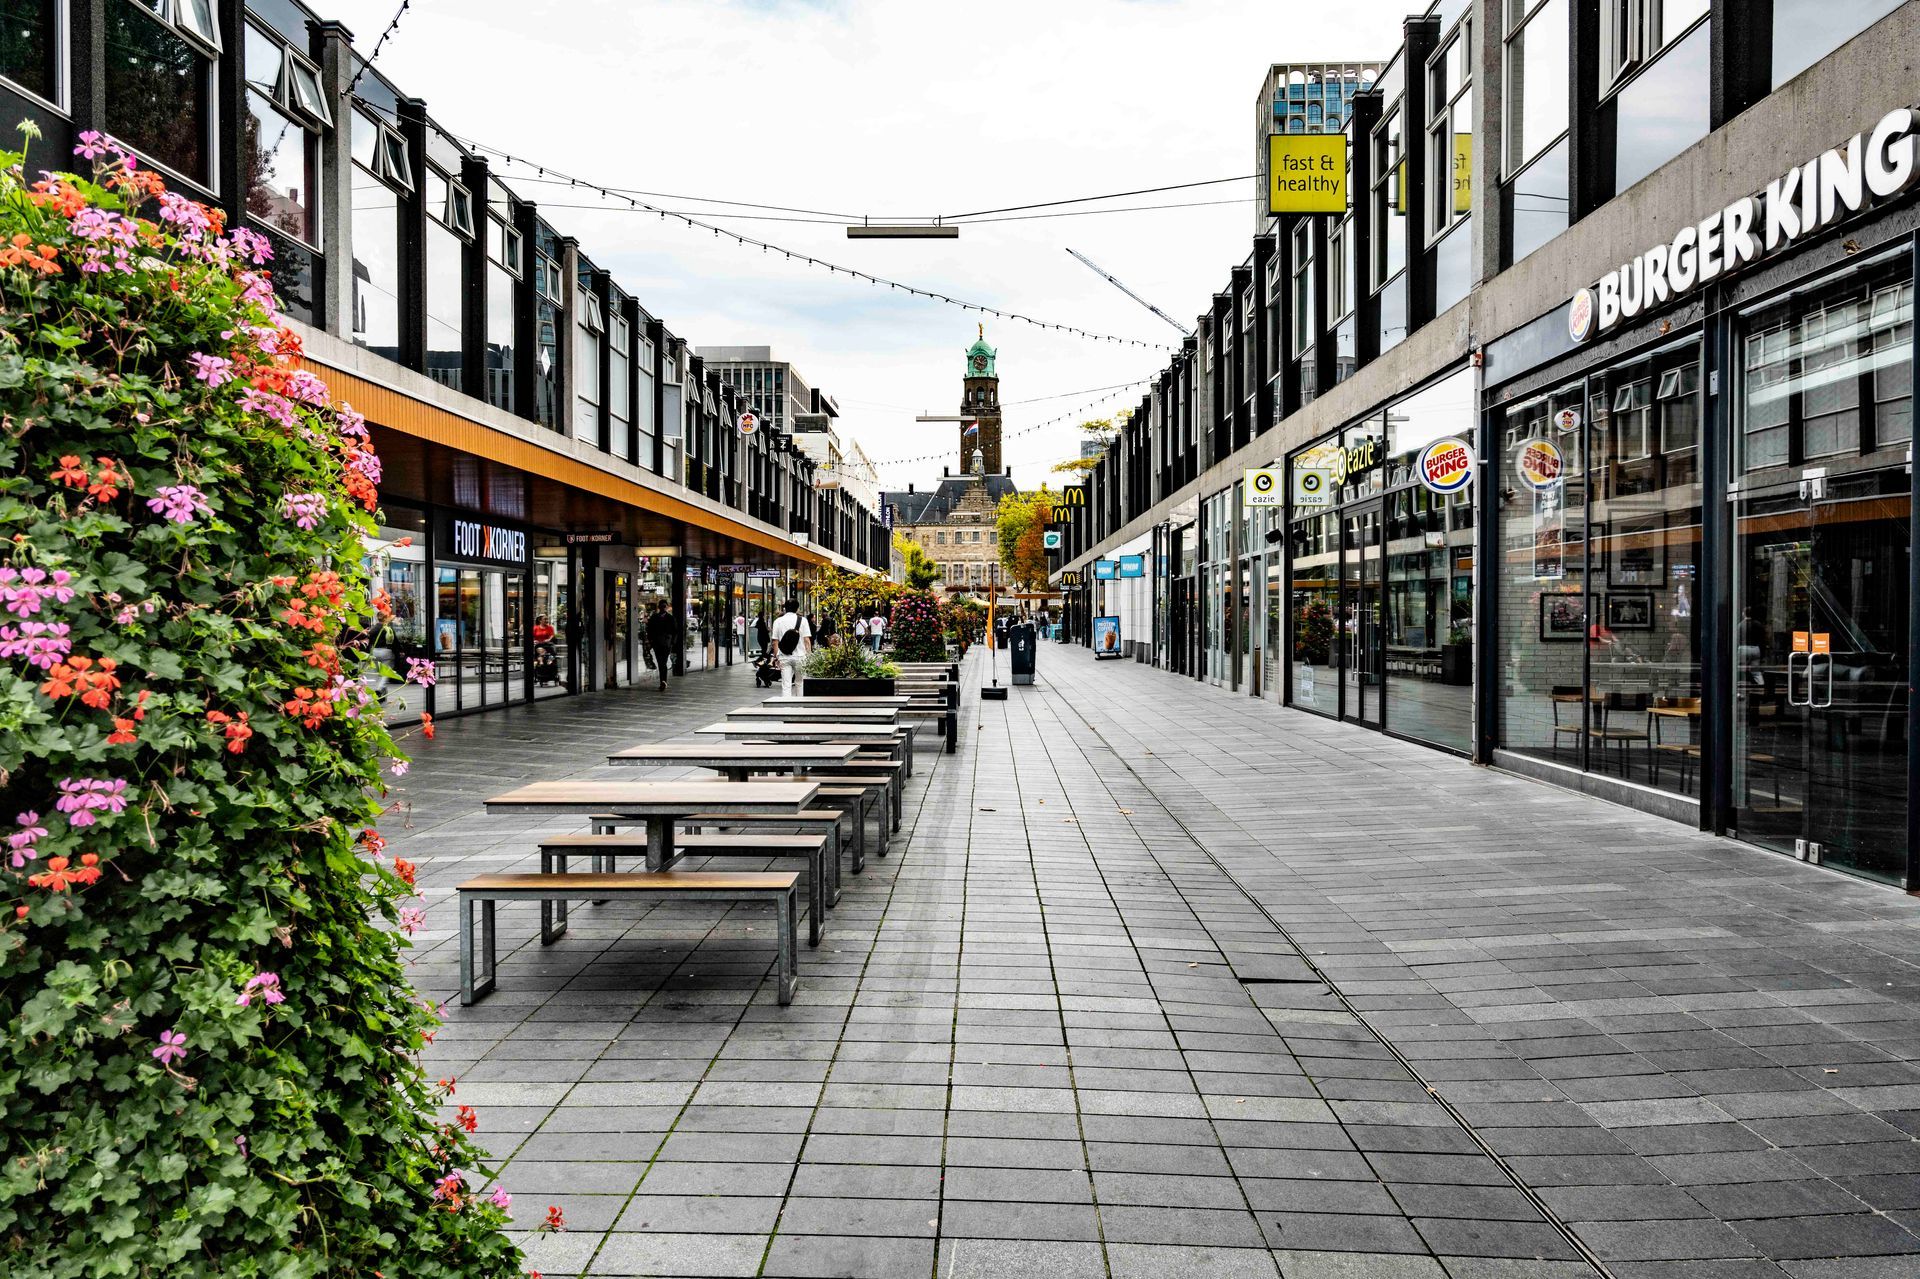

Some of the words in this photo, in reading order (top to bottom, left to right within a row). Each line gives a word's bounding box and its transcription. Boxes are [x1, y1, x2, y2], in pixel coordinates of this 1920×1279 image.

[1283, 154, 1314, 171] fast
[1320, 155, 1335, 170] &
[1277, 175, 1340, 195] healthy
[1599, 197, 1755, 330] BURGER
[1766, 108, 1914, 250] KING
[1573, 306, 1589, 328] KING
[1347, 441, 1374, 474] eazie
[1426, 447, 1465, 470] BURGER
[1429, 456, 1468, 482] KING
[1252, 495, 1275, 503] eazie
[455, 520, 481, 557] FOOT
